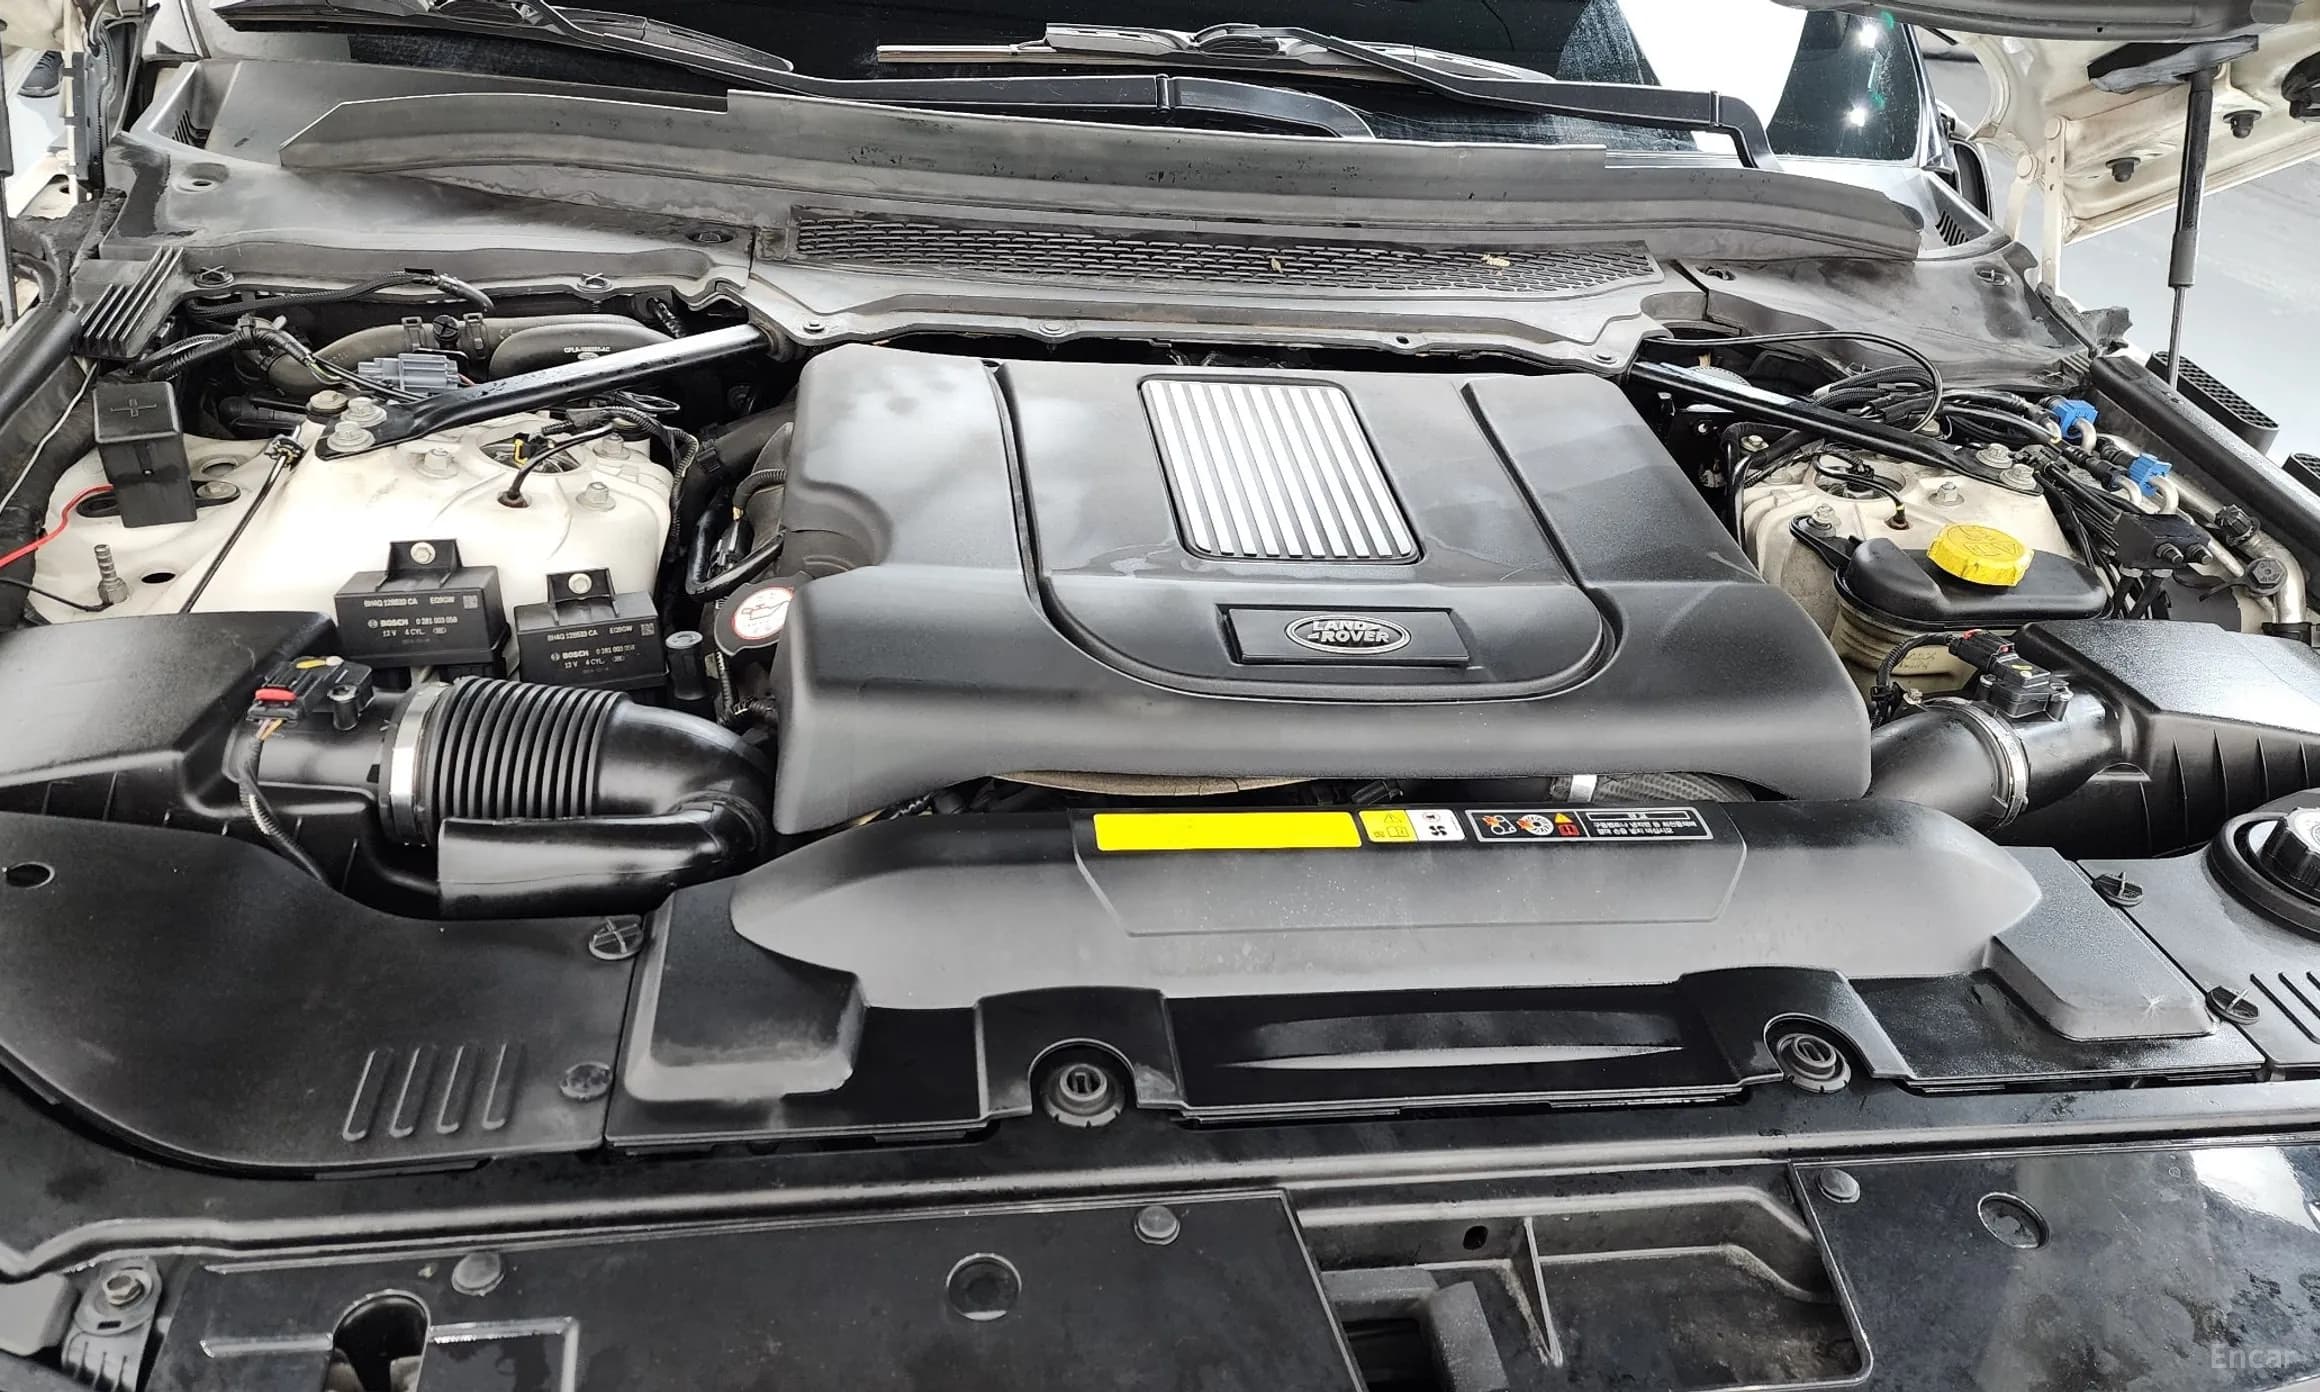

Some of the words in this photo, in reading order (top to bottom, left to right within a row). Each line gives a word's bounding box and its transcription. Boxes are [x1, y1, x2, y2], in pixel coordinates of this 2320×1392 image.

[380, 618, 409, 628] BOSCH
[1312, 619, 1367, 631] LAND
[1320, 630, 1390, 643] ROVER
[562, 649, 590, 660] BOSCH
